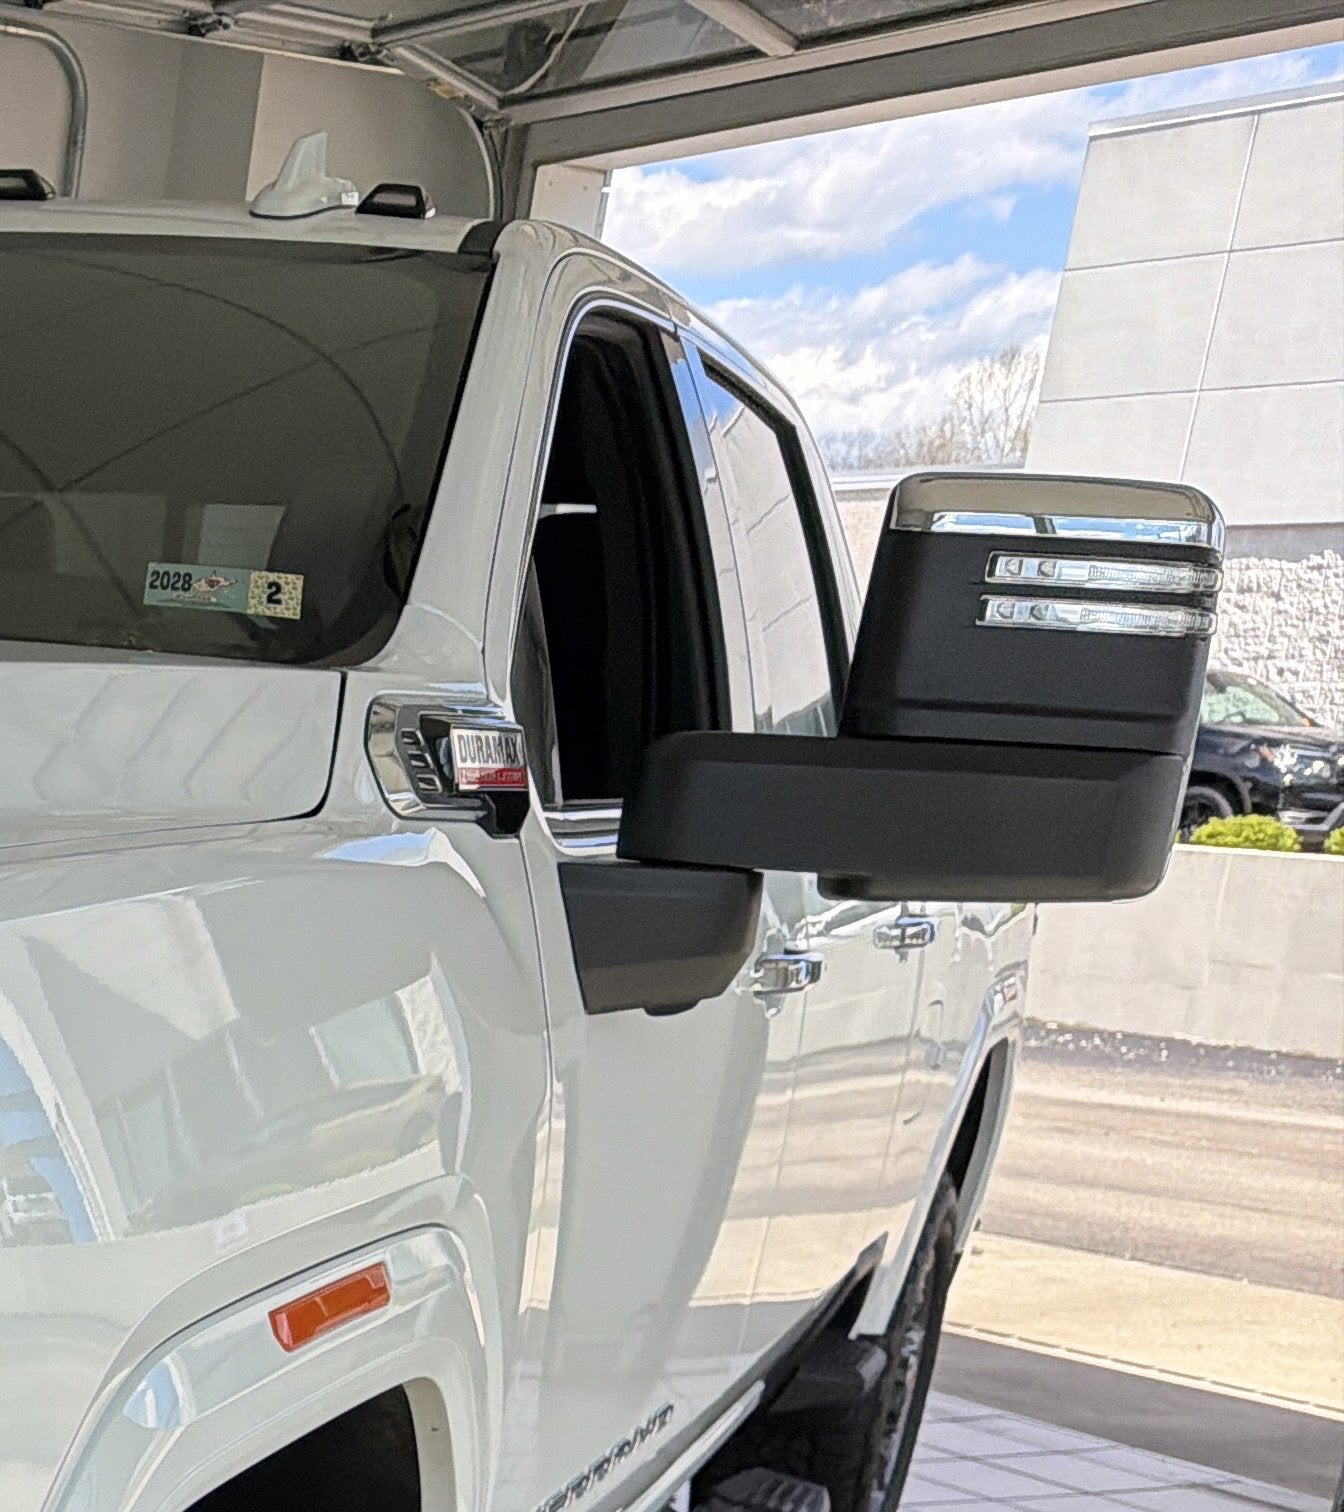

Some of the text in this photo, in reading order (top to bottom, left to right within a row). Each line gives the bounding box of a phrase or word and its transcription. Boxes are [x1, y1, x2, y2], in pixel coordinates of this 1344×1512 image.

[148, 570, 193, 592] 2028
[266, 581, 283, 605] 2
[457, 734, 523, 764] DURAMAX
